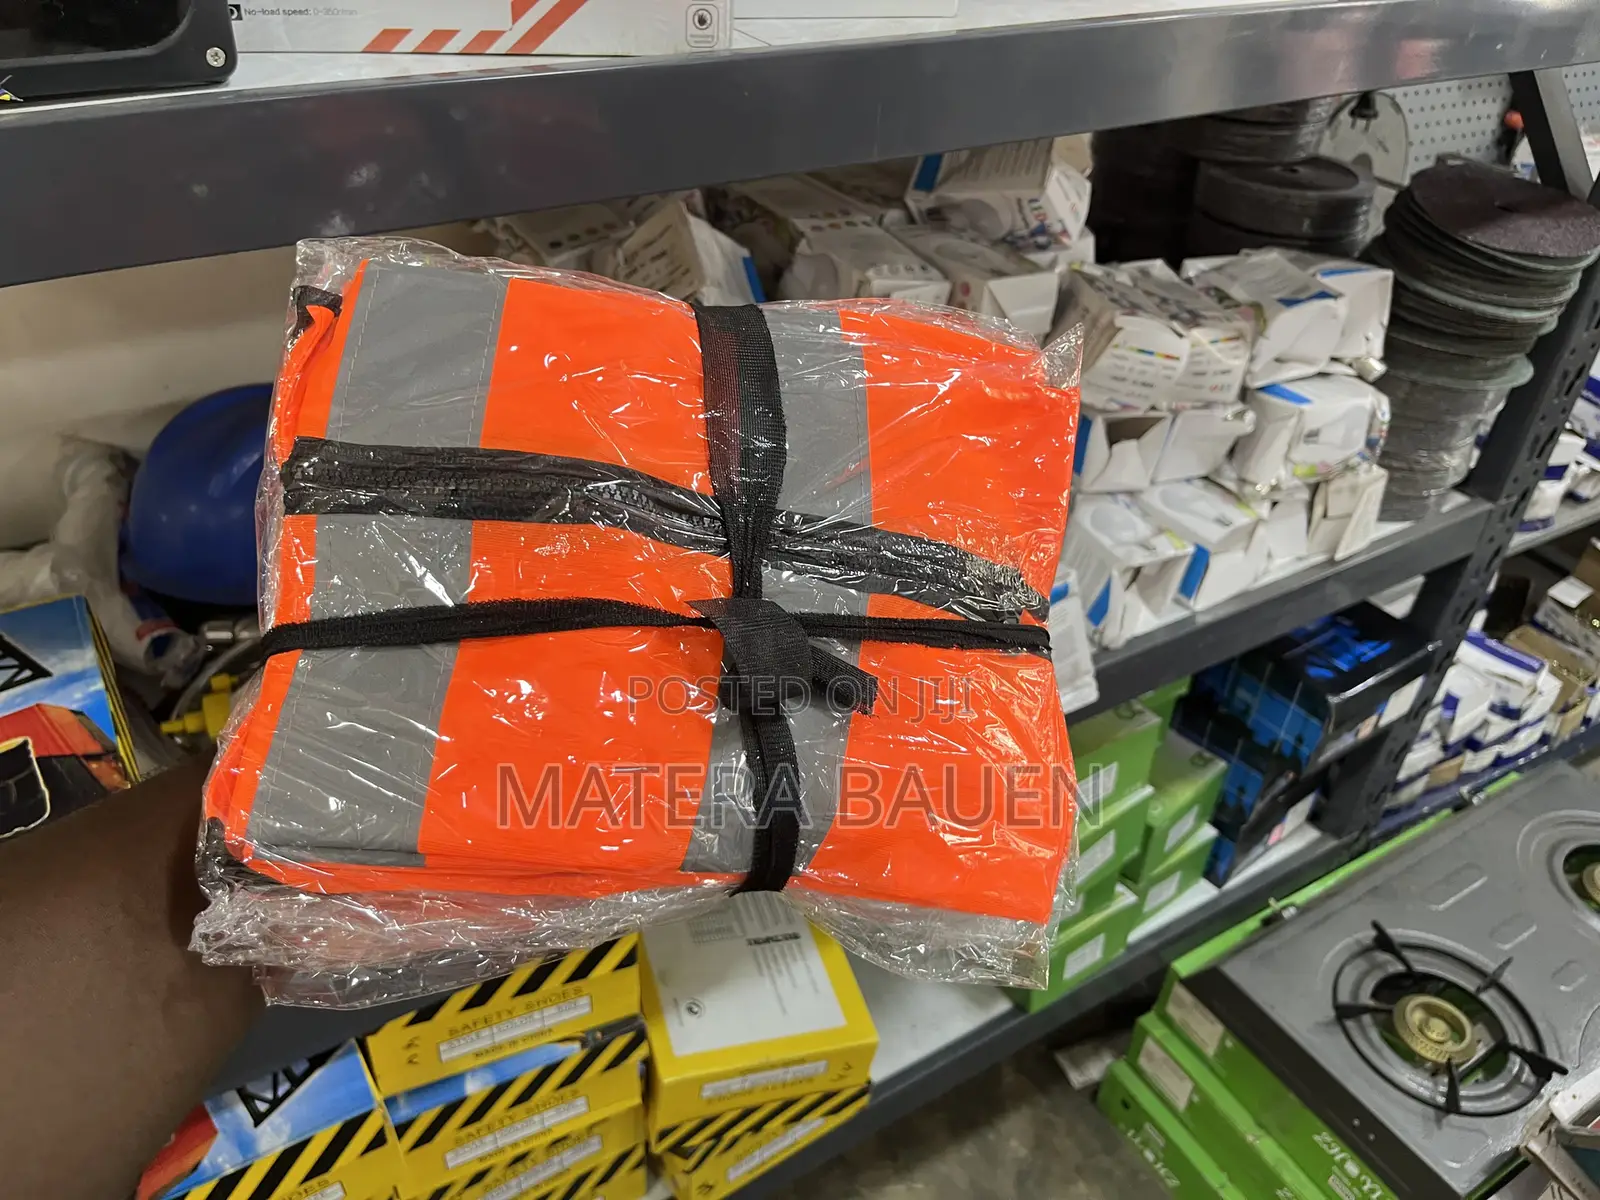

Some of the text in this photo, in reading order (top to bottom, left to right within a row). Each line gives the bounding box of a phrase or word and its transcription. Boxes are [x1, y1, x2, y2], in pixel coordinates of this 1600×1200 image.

[244, 8, 280, 16] No-load
[282, 8, 312, 17] speed:
[448, 1006, 516, 1037] SAFETY
[525, 986, 584, 1010] SHOES
